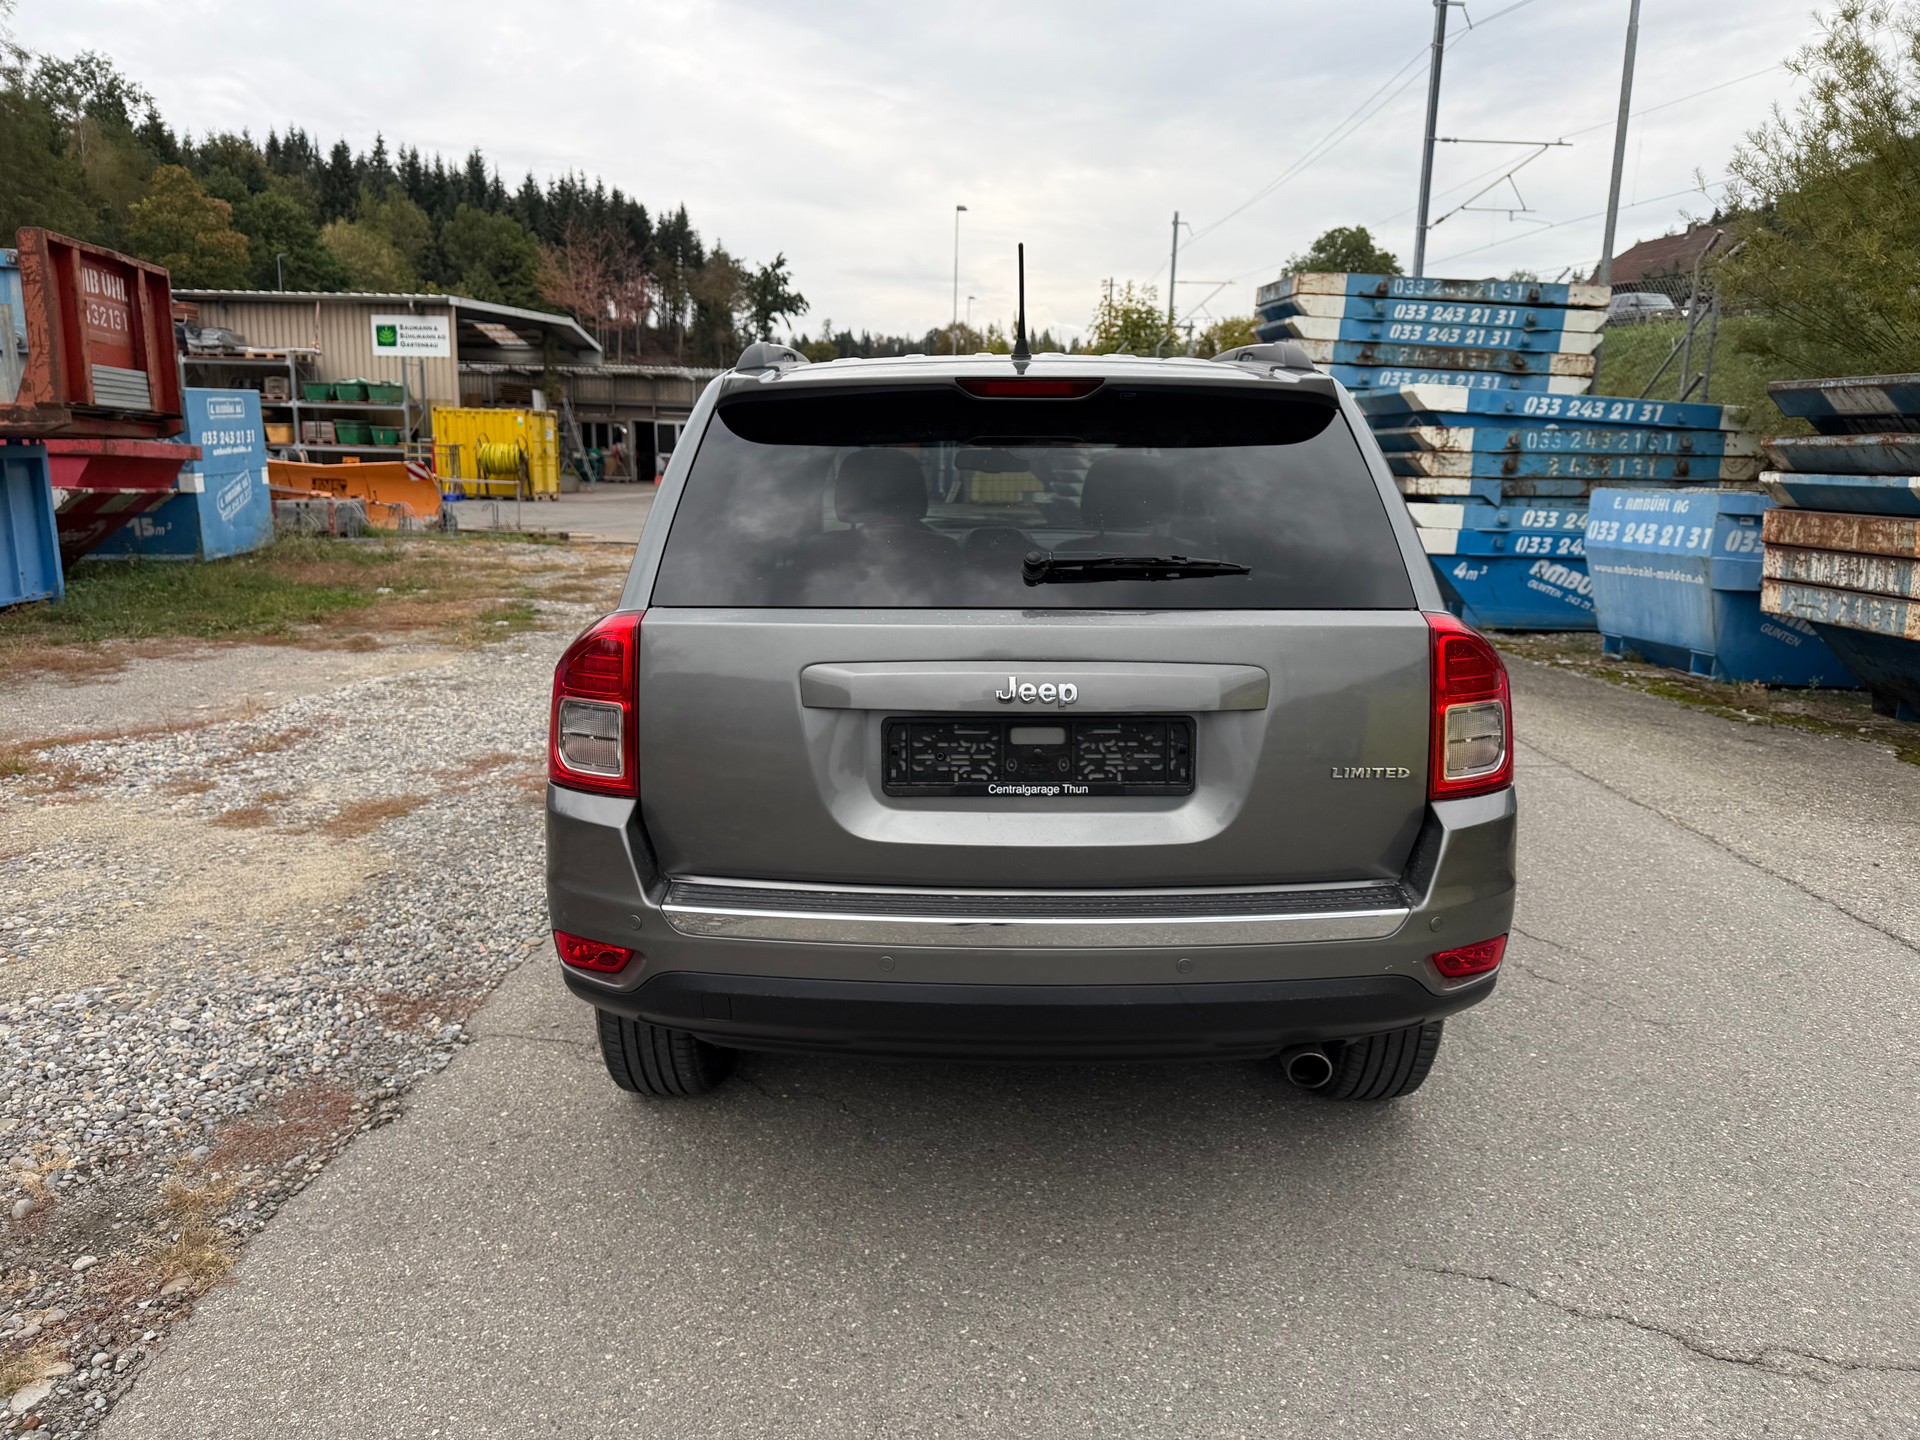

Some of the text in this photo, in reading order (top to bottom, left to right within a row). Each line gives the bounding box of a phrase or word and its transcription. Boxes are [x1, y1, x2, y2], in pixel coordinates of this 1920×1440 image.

[1393, 279, 1425, 295] 033
[1394, 304, 1517, 325] 033 243 21 31
[1389, 323, 1512, 346] 033 243 21 31
[1380, 371, 1501, 389] 033 243 21 31
[1524, 396, 1665, 422] 033 243 21 31
[202, 429, 255, 445] 033 243 21 31
[1527, 431, 1561, 449] 033
[1625, 495, 1670, 512] AMBÜHL
[1672, 499, 1690, 514] AG
[1522, 509, 1560, 528] 033
[1587, 520, 1714, 551] 033 243 21 31
[1515, 536, 1587, 555] 033 24
[1528, 559, 1594, 598] AMBU
[1594, 563, 1705, 585] www.ambuehl-mulden.ch
[1760, 623, 1803, 648] GUNTEN
[996, 676, 1078, 710] Jeep
[1331, 767, 1411, 779] LIMITED
[988, 783, 1089, 796] Centralgarage Thun
